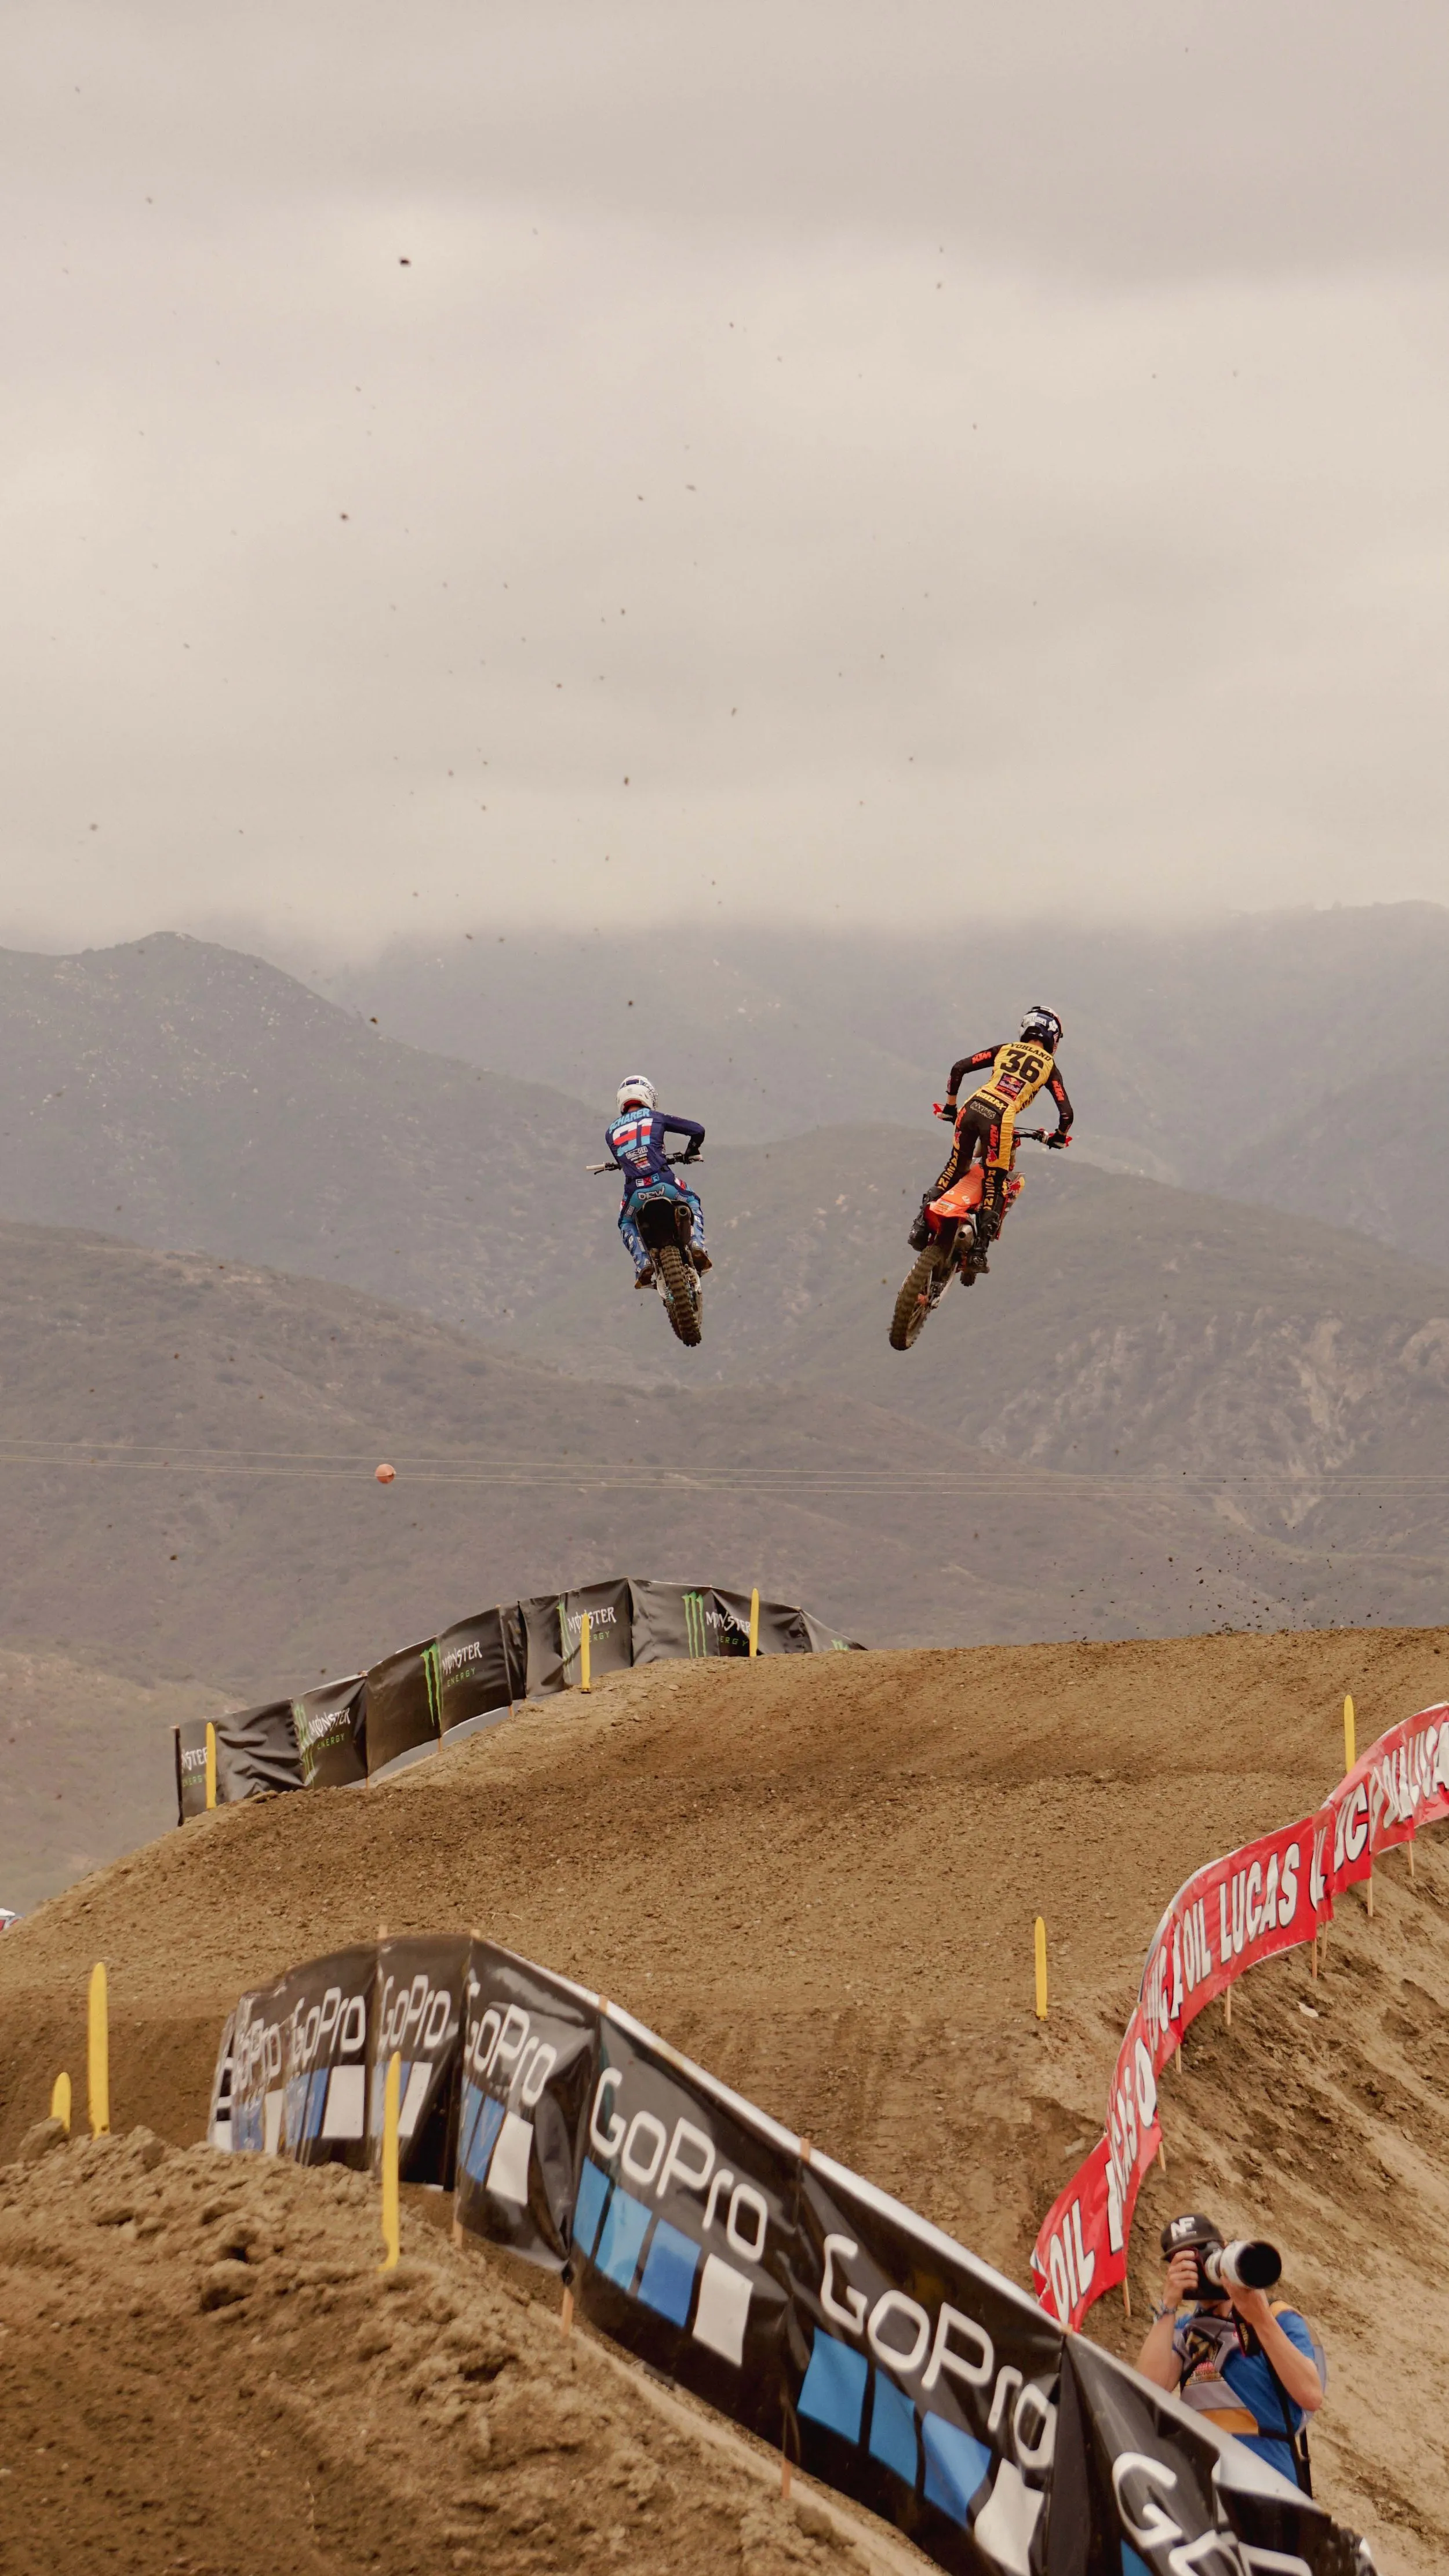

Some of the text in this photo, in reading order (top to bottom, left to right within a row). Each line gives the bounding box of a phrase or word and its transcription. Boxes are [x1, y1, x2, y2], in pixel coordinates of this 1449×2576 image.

[972, 1051, 991, 1064] KTM
[1000, 1049, 1044, 1083] 36
[1011, 1044, 1051, 1061] VOHLAND
[1052, 1080, 1064, 1101] KTM
[609, 1108, 650, 1134] SCHARER
[613, 1118, 653, 1156] 91
[636, 1173, 659, 1187] FXR
[567, 1607, 617, 1633] MOSTER
[442, 1642, 482, 1676] MONSTER
[447, 1667, 475, 1687] ENERGY
[308, 1708, 351, 1737] MONSTER
[1182, 1897, 1213, 1994] OIL
[1219, 1842, 1300, 1964] LUCAS
[379, 1974, 451, 2050] GoPro
[590, 2066, 768, 2262] GoPro
[1170, 2217, 1195, 2242] NF
[1050, 2199, 1095, 2326] OIL
[820, 2233, 1057, 2467] GoPro
